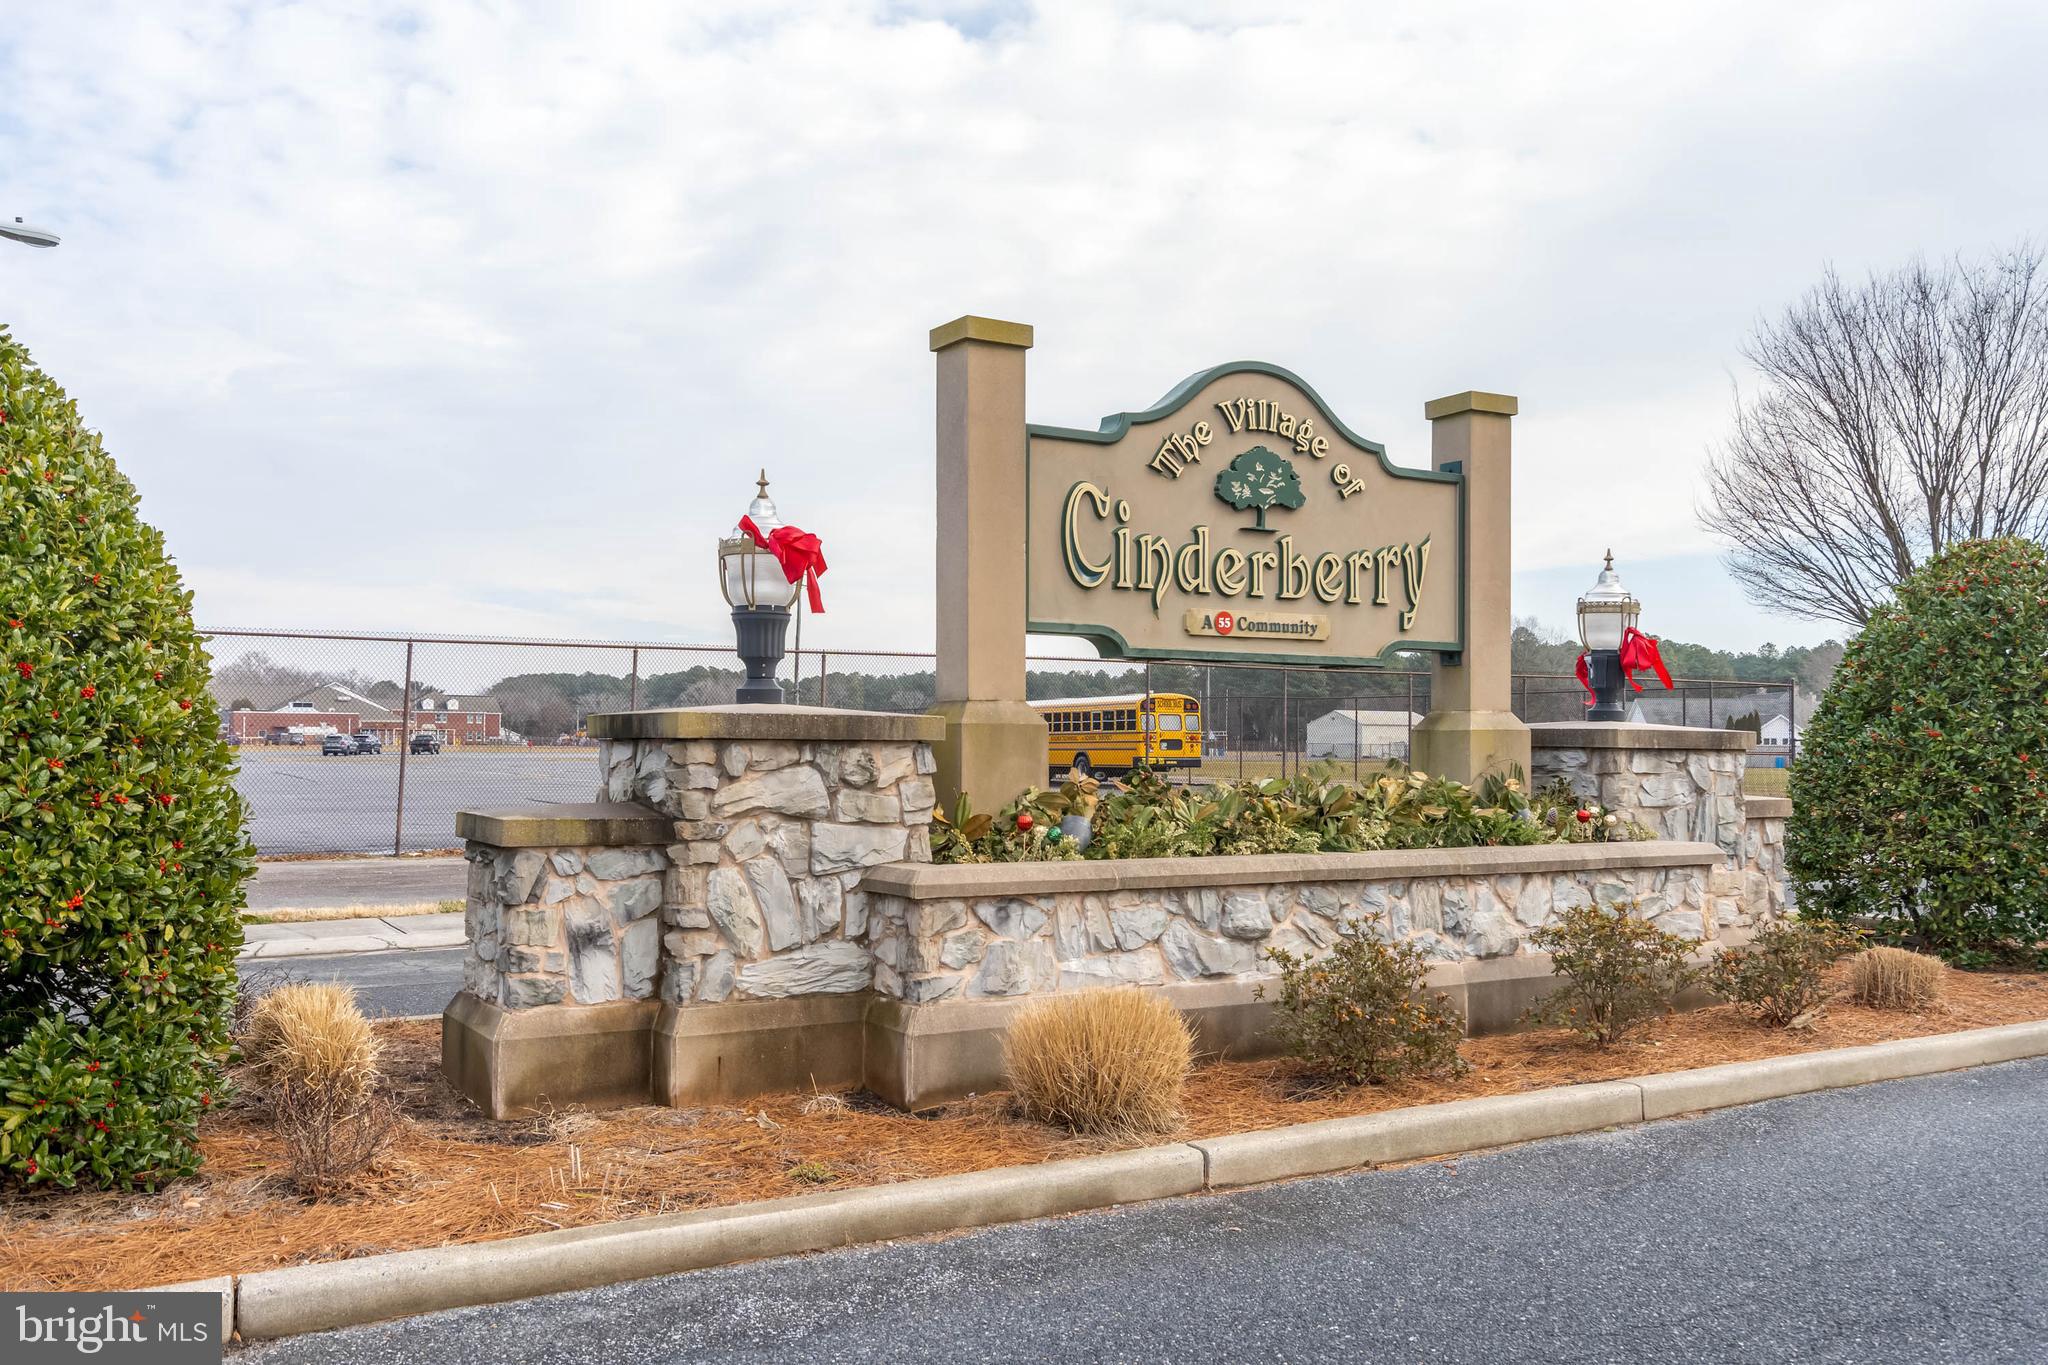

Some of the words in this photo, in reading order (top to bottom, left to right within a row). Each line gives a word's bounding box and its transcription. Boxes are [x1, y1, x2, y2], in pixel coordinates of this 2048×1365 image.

[1150, 420, 1213, 479] The
[1217, 397, 1330, 459] Village
[1330, 462, 1366, 500] of
[1062, 480, 1432, 630] Cinderberry
[1201, 614, 1213, 630] A
[1218, 617, 1231, 628] 55
[1237, 616, 1318, 636] Community
